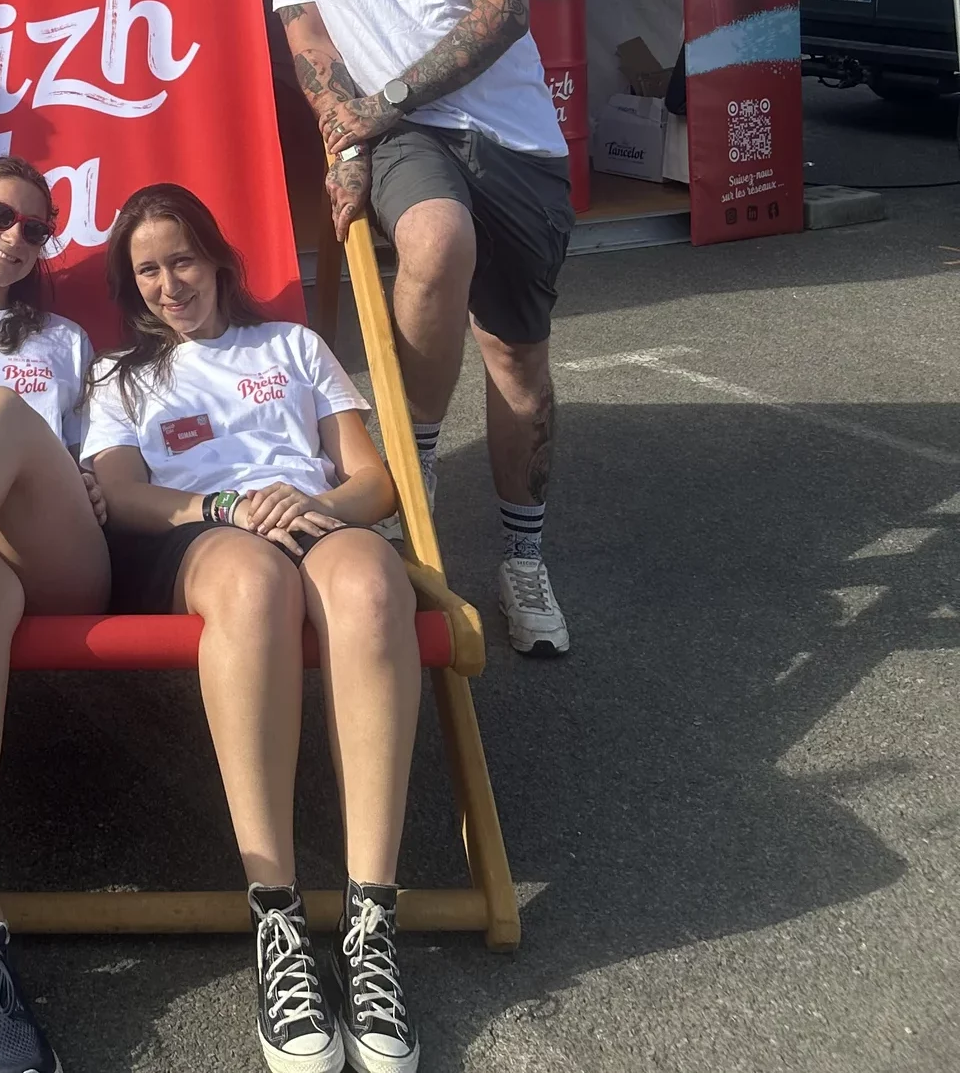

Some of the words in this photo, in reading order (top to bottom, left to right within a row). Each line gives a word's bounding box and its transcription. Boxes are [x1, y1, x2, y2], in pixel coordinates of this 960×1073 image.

[728, 168, 774, 187] Suivez-nous
[721, 191, 734, 203] sur
[735, 187, 746, 199] les
[747, 181, 777, 196] réseaux
[2, 364, 54, 380] Breizh
[14, 378, 48, 394] Cola
[237, 371, 289, 400] Breizh
[253, 386, 285, 404] Cola
